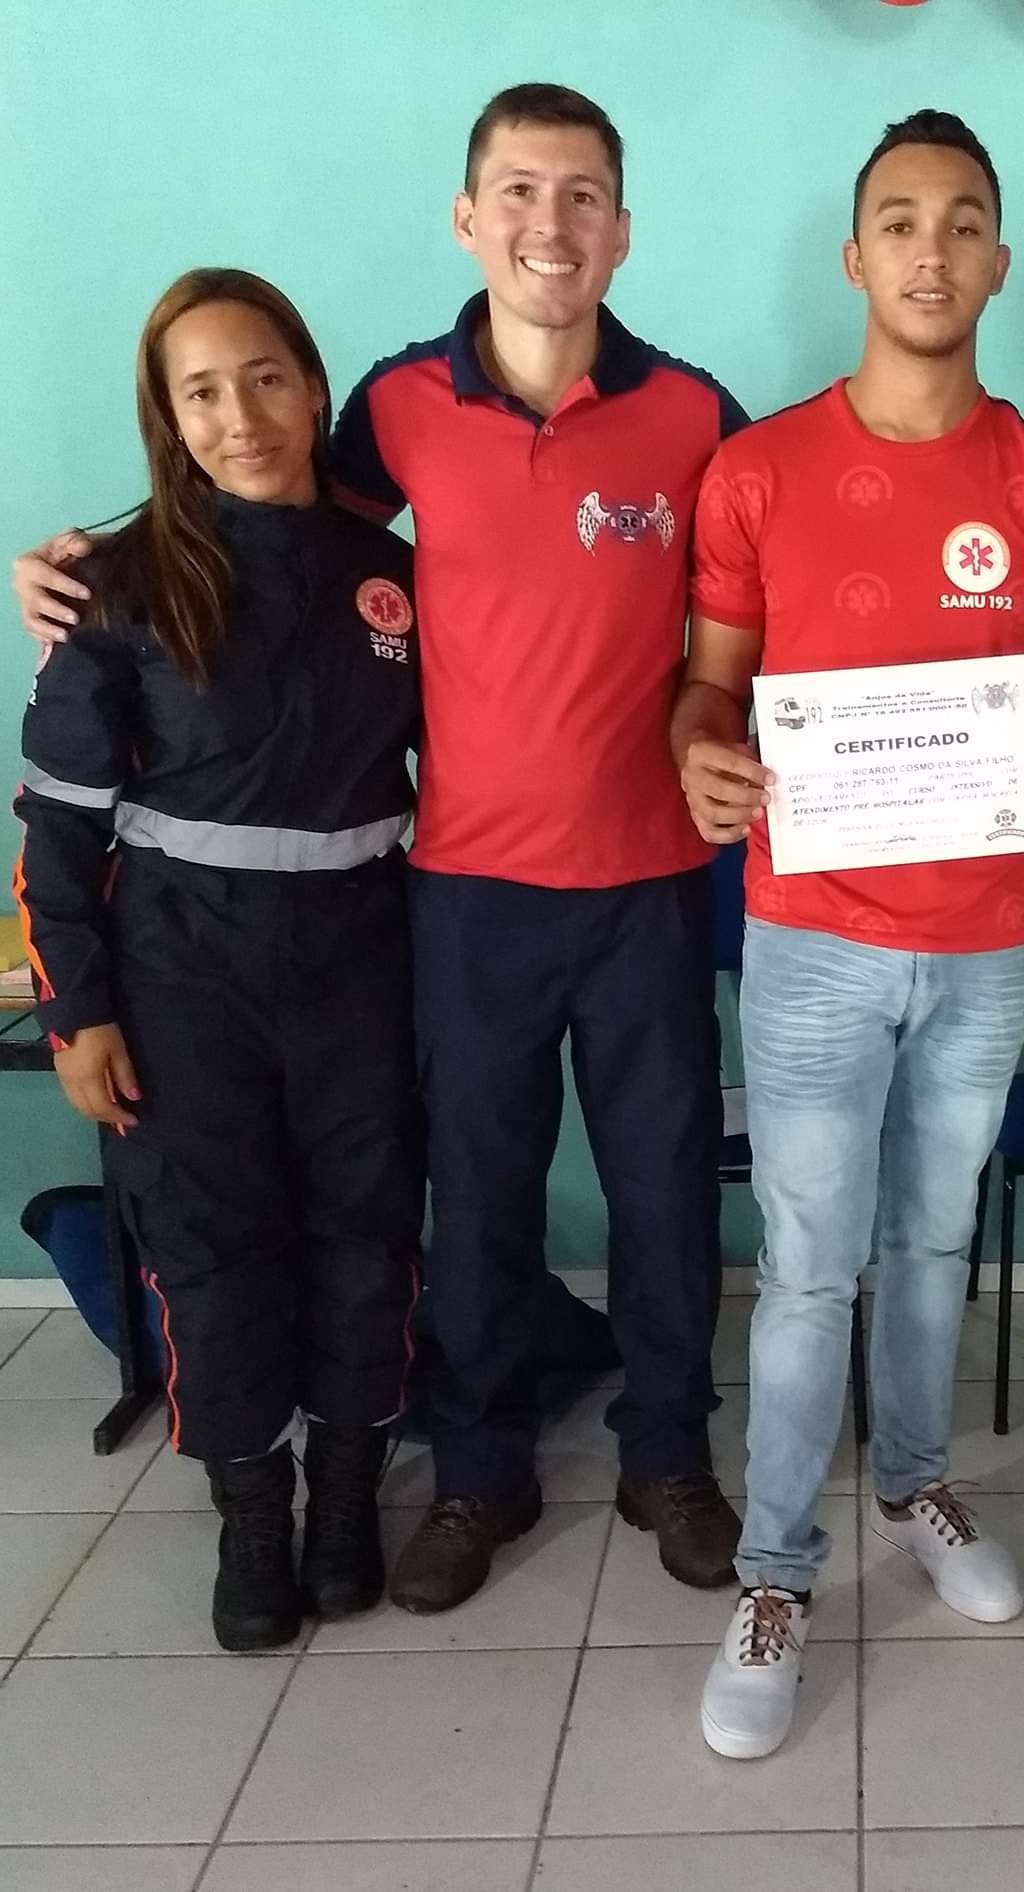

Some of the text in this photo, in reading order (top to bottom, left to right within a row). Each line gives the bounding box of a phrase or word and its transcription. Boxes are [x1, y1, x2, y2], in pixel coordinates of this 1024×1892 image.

[940, 594, 1013, 610] SAMU 192
[369, 631, 408, 650] SAMU
[370, 643, 409, 664] 192
[805, 705, 824, 725] 192
[834, 732, 969, 754] CERTIFICADO
[852, 764, 896, 777] RICARDO
[899, 761, 935, 773] COSMO
[937, 760, 952, 769] DA
[955, 757, 983, 769] SILVA
[985, 754, 1015, 766] FILHO
[788, 783, 808, 794] CPF
